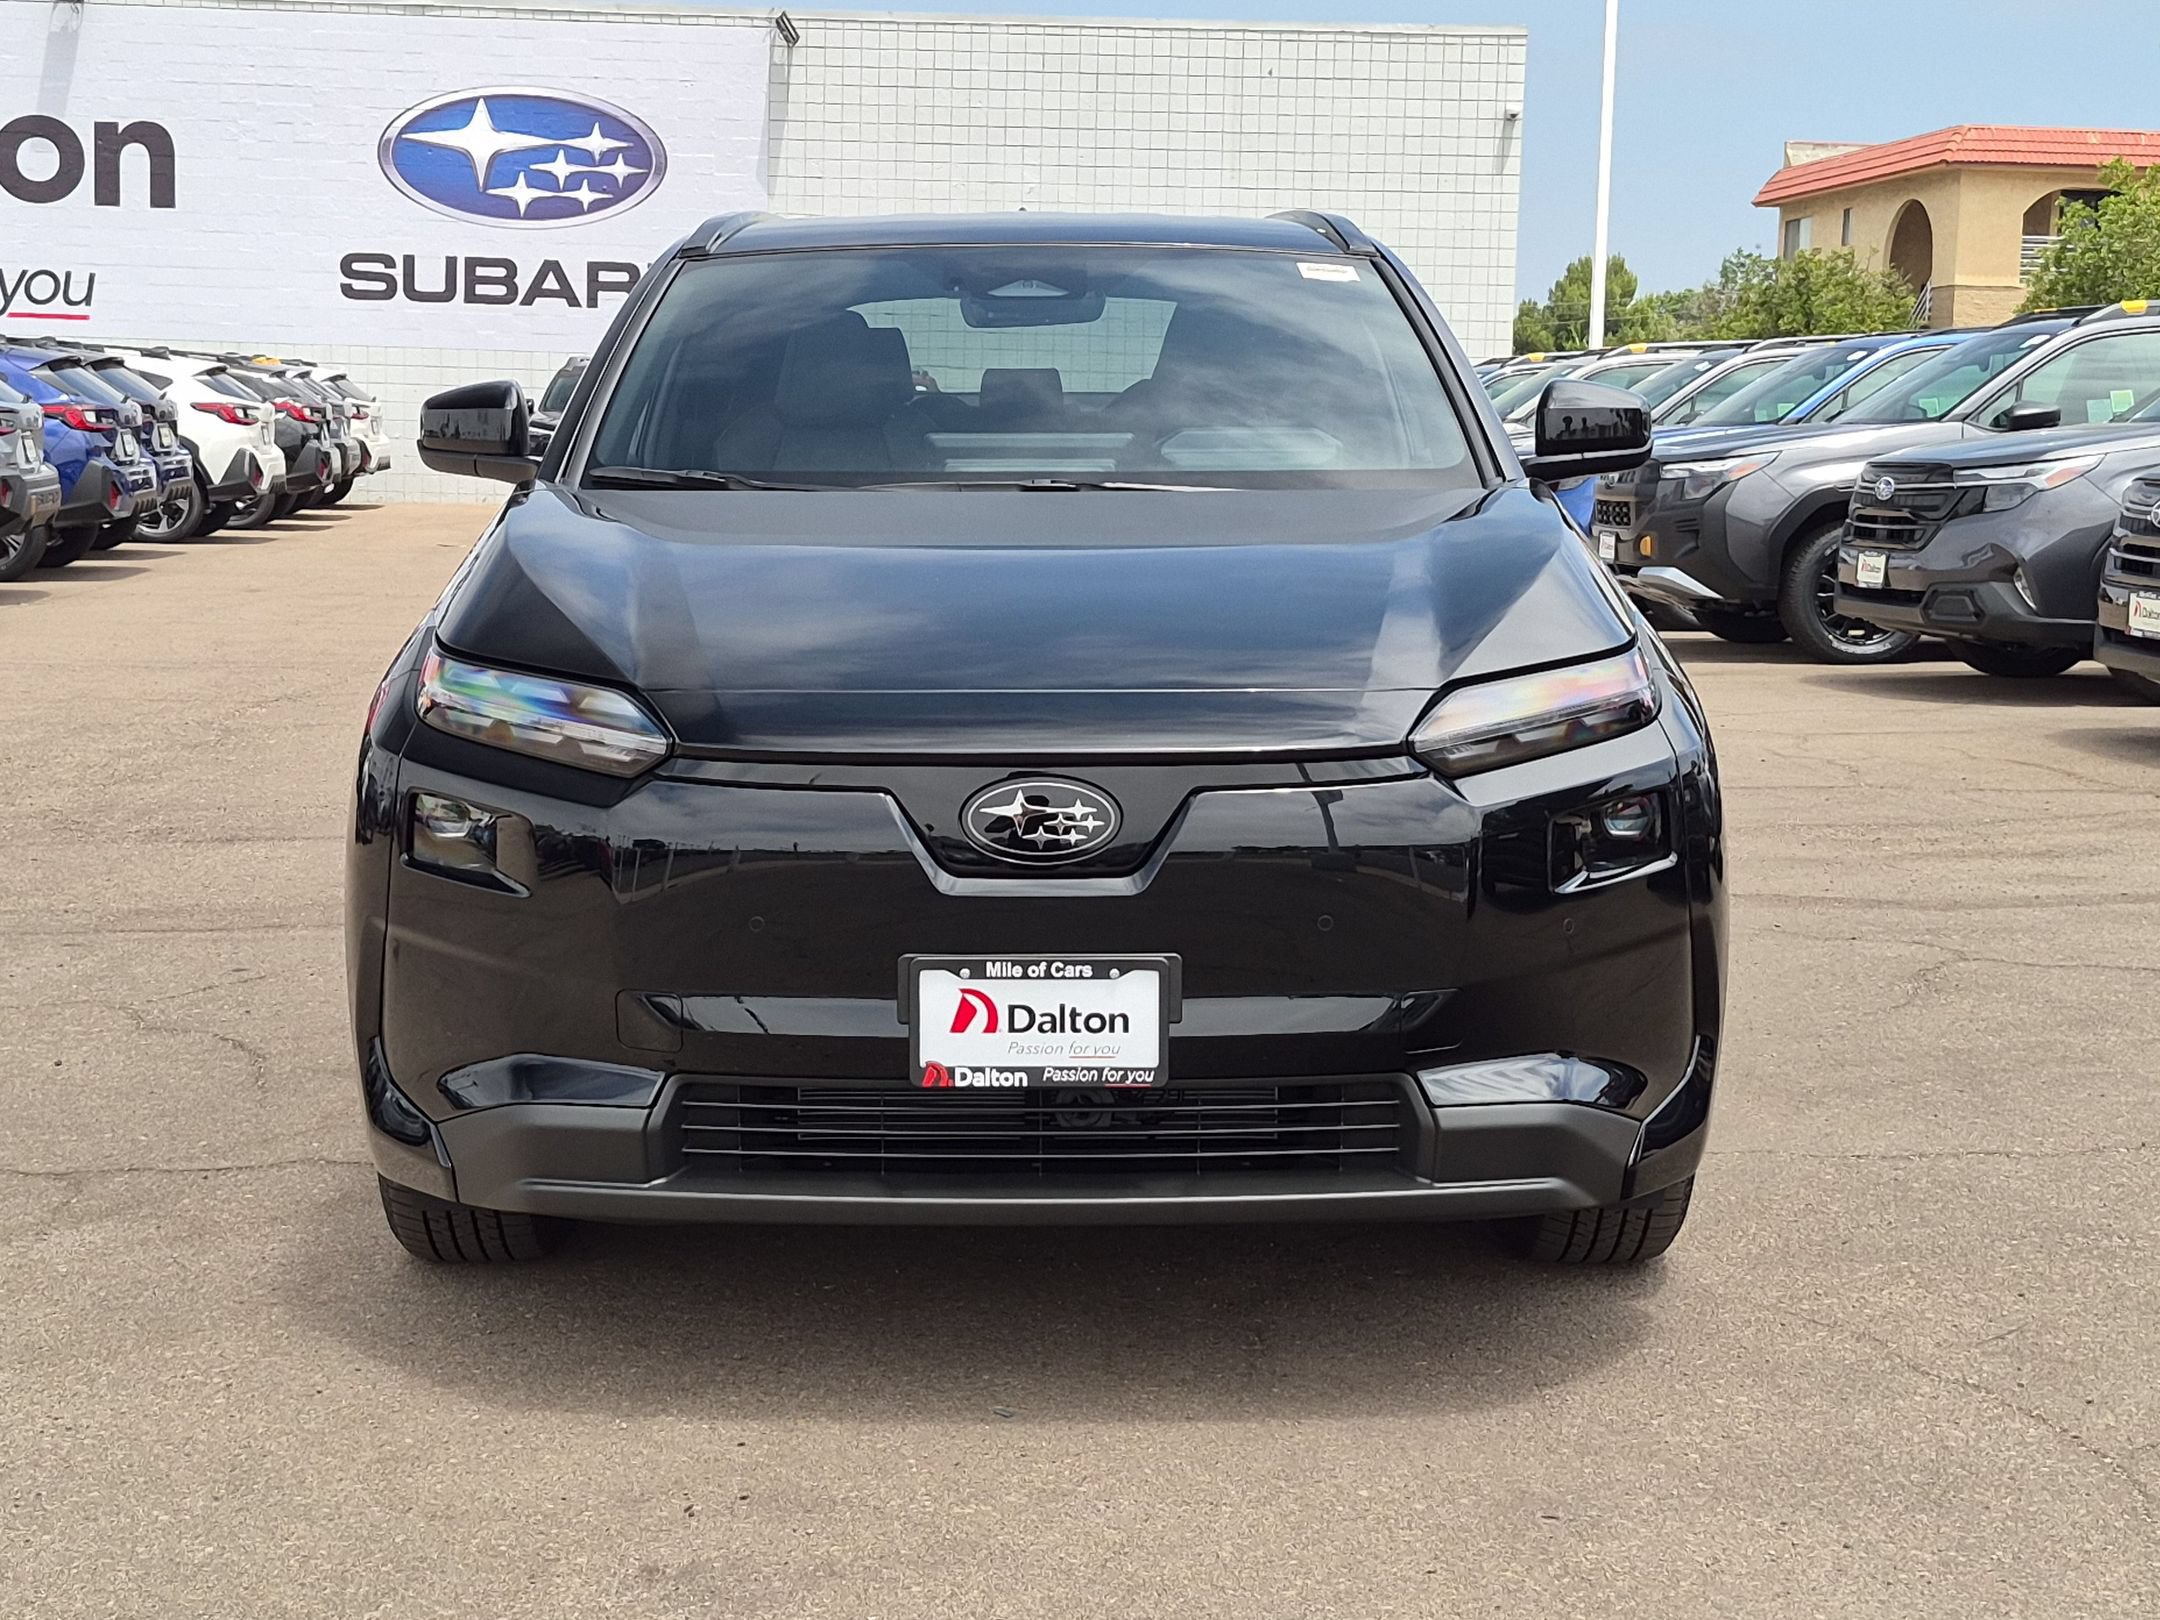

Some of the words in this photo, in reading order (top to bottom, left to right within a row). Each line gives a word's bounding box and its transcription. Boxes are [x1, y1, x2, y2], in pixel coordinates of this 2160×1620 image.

[0, 115, 176, 208] on
[0, 268, 96, 317] you
[340, 252, 653, 308] SUBAR
[986, 961, 1022, 978] Mile
[1027, 961, 1047, 978] of
[1050, 961, 1093, 978] Cars
[1007, 1003, 1130, 1034] Dalton
[1007, 1041, 1064, 1056] Passion
[1069, 1041, 1090, 1056] for
[1093, 1044, 1121, 1056] you
[954, 1067, 1028, 1088] Dalton
[1042, 1067, 1098, 1083] Passion
[1102, 1067, 1123, 1084] for
[1124, 1069, 1155, 1083] you
